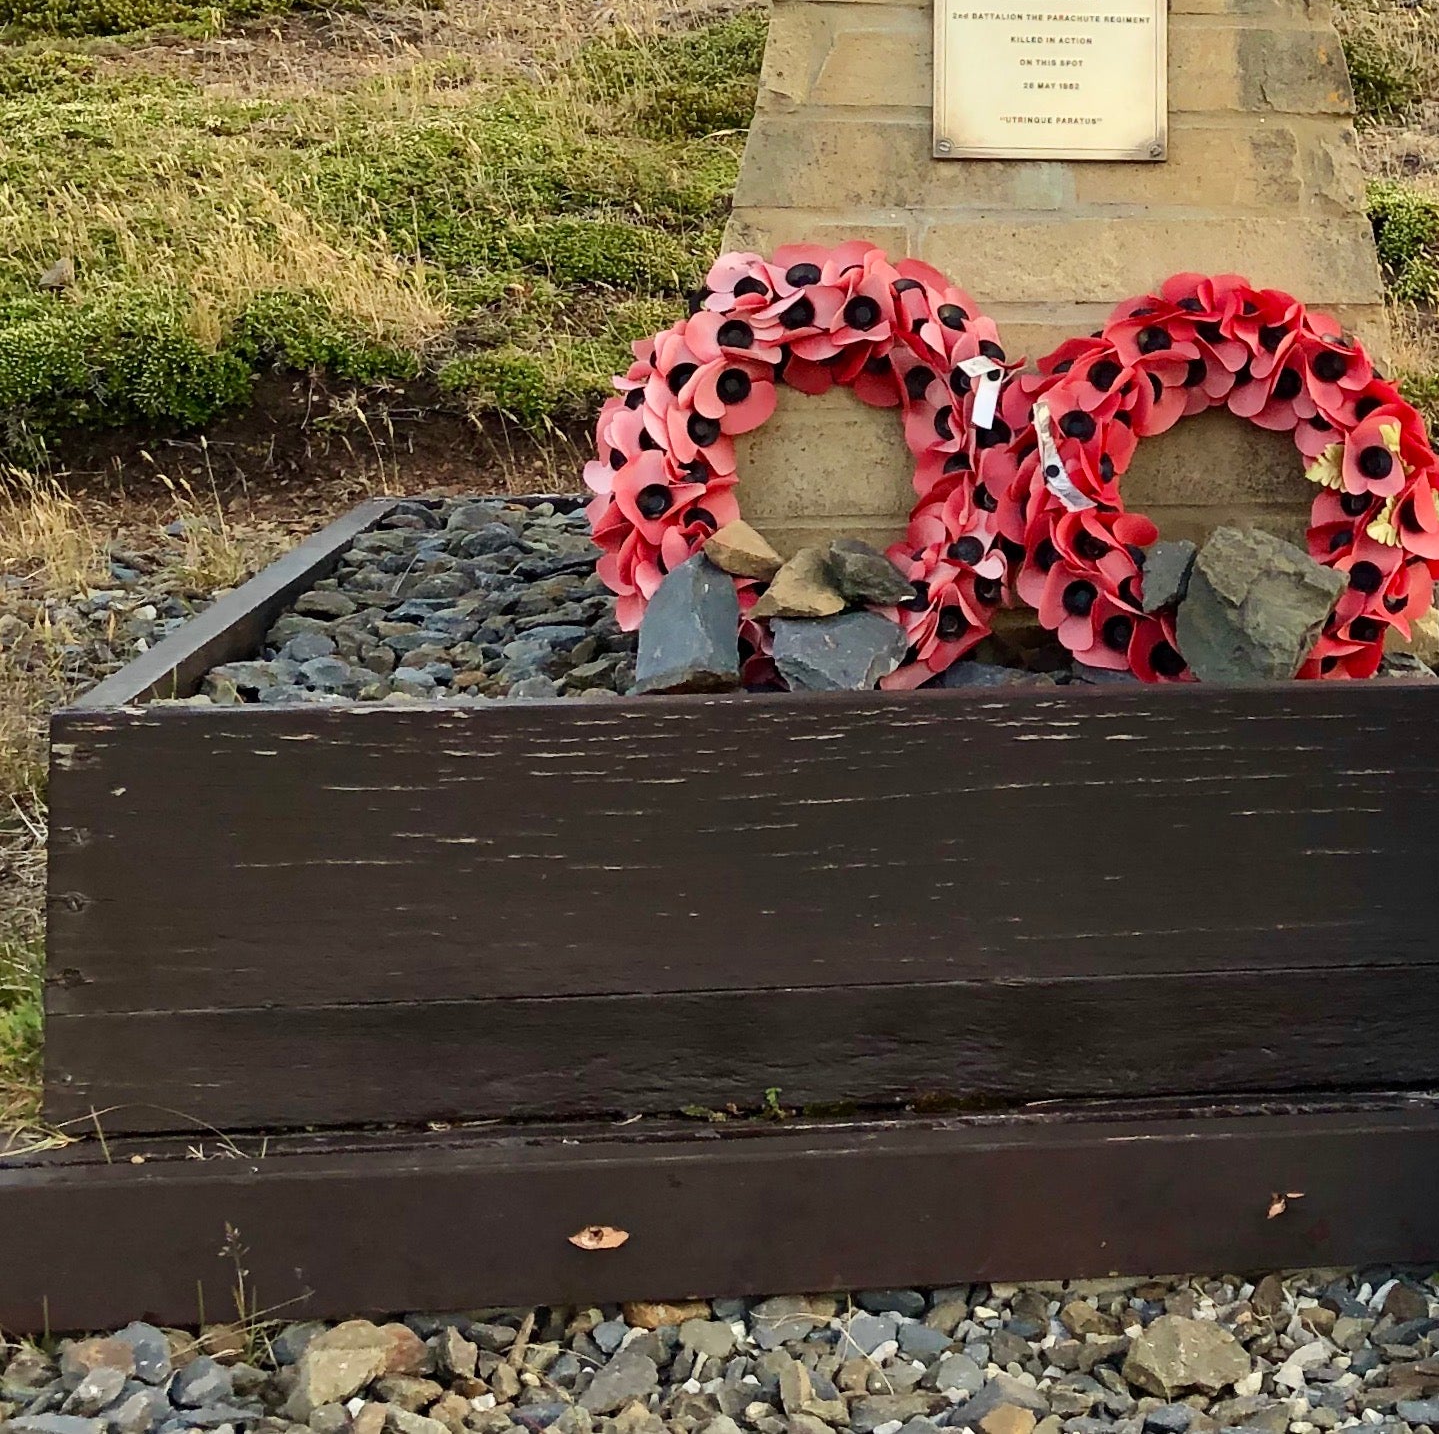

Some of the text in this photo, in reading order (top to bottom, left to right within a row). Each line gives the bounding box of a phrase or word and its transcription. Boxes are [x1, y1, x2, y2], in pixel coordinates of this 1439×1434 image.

[952, 12, 1151, 23] 2nd BATTALION THE PARACHUTE REGIMENT
